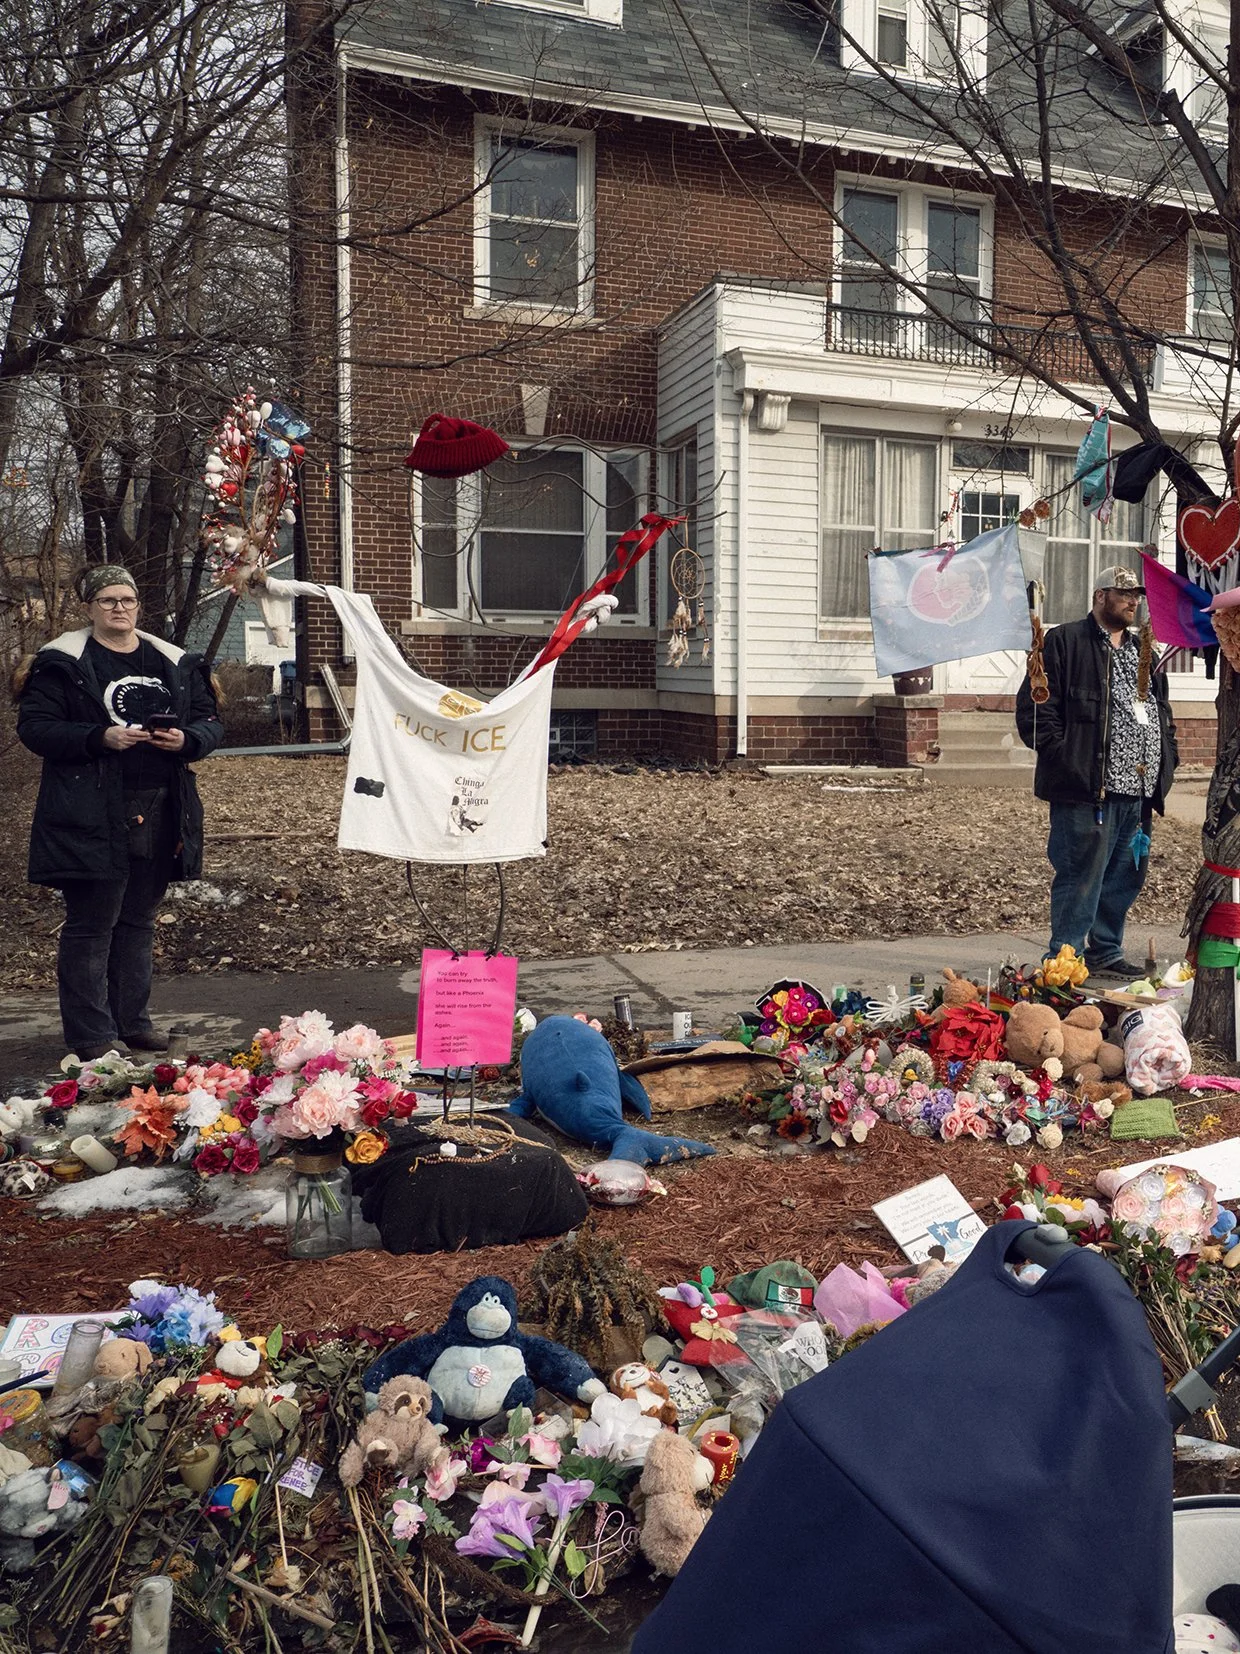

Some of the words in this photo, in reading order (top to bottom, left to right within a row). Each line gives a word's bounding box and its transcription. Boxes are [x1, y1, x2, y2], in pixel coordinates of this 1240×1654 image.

[394, 712, 448, 748] FUCK
[461, 725, 507, 753] ICE
[959, 1222, 983, 1241] Good
[287, 1467, 305, 1480] FOR
[293, 1459, 320, 1477] STICE
